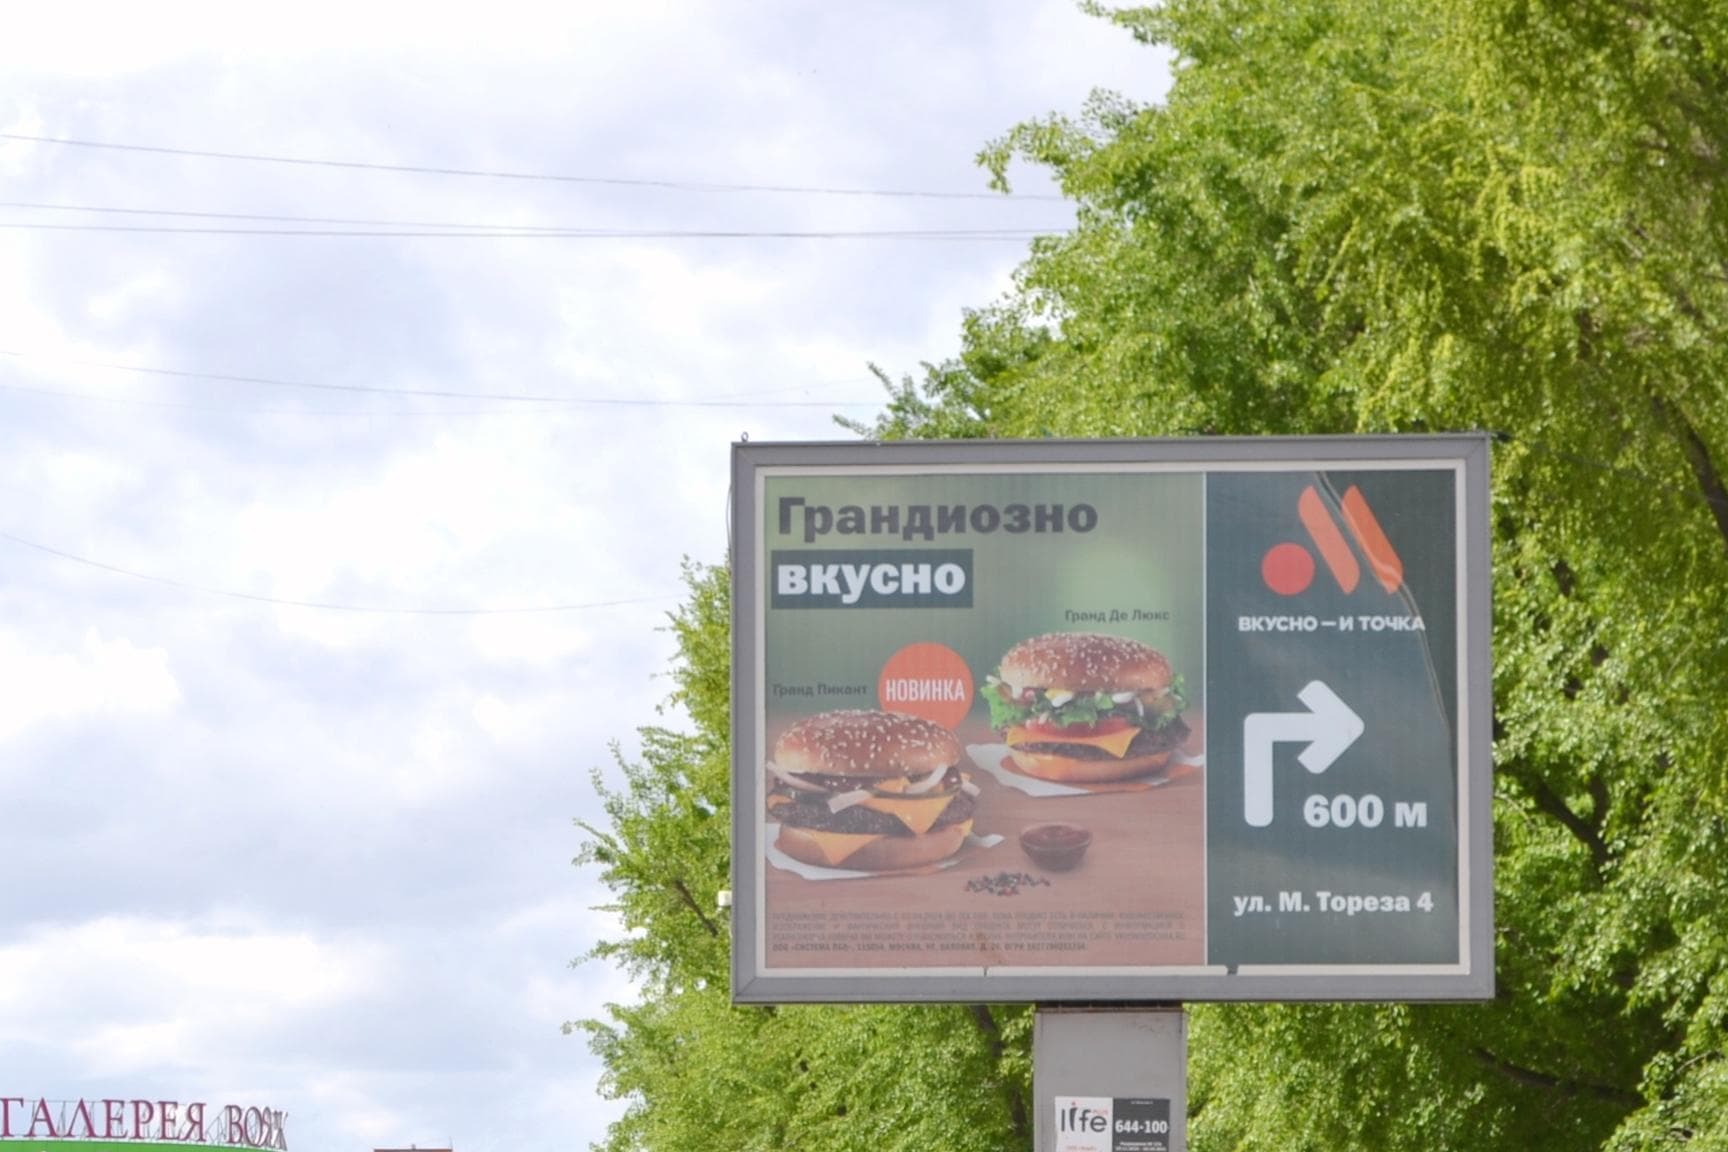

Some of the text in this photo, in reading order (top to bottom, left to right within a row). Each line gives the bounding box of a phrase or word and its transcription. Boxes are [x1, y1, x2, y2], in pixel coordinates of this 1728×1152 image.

[778, 496, 1099, 543] Грандиозно
[777, 563, 967, 604] вкусно
[1065, 608, 1170, 624] Гранд Де Люкс
[1237, 615, 1319, 632] ВКУСНО
[1338, 615, 1354, 632] И
[1357, 615, 1427, 632] ТОЧКА
[772, 683, 869, 698] Гранд Пикант
[885, 678, 967, 702] НОВИНКА
[1303, 793, 1428, 829] 600 м
[1232, 890, 1435, 917] ул. М. Тореза 4
[223, 1103, 289, 1152] ВОЯЖ
[1060, 1101, 1108, 1133] life
